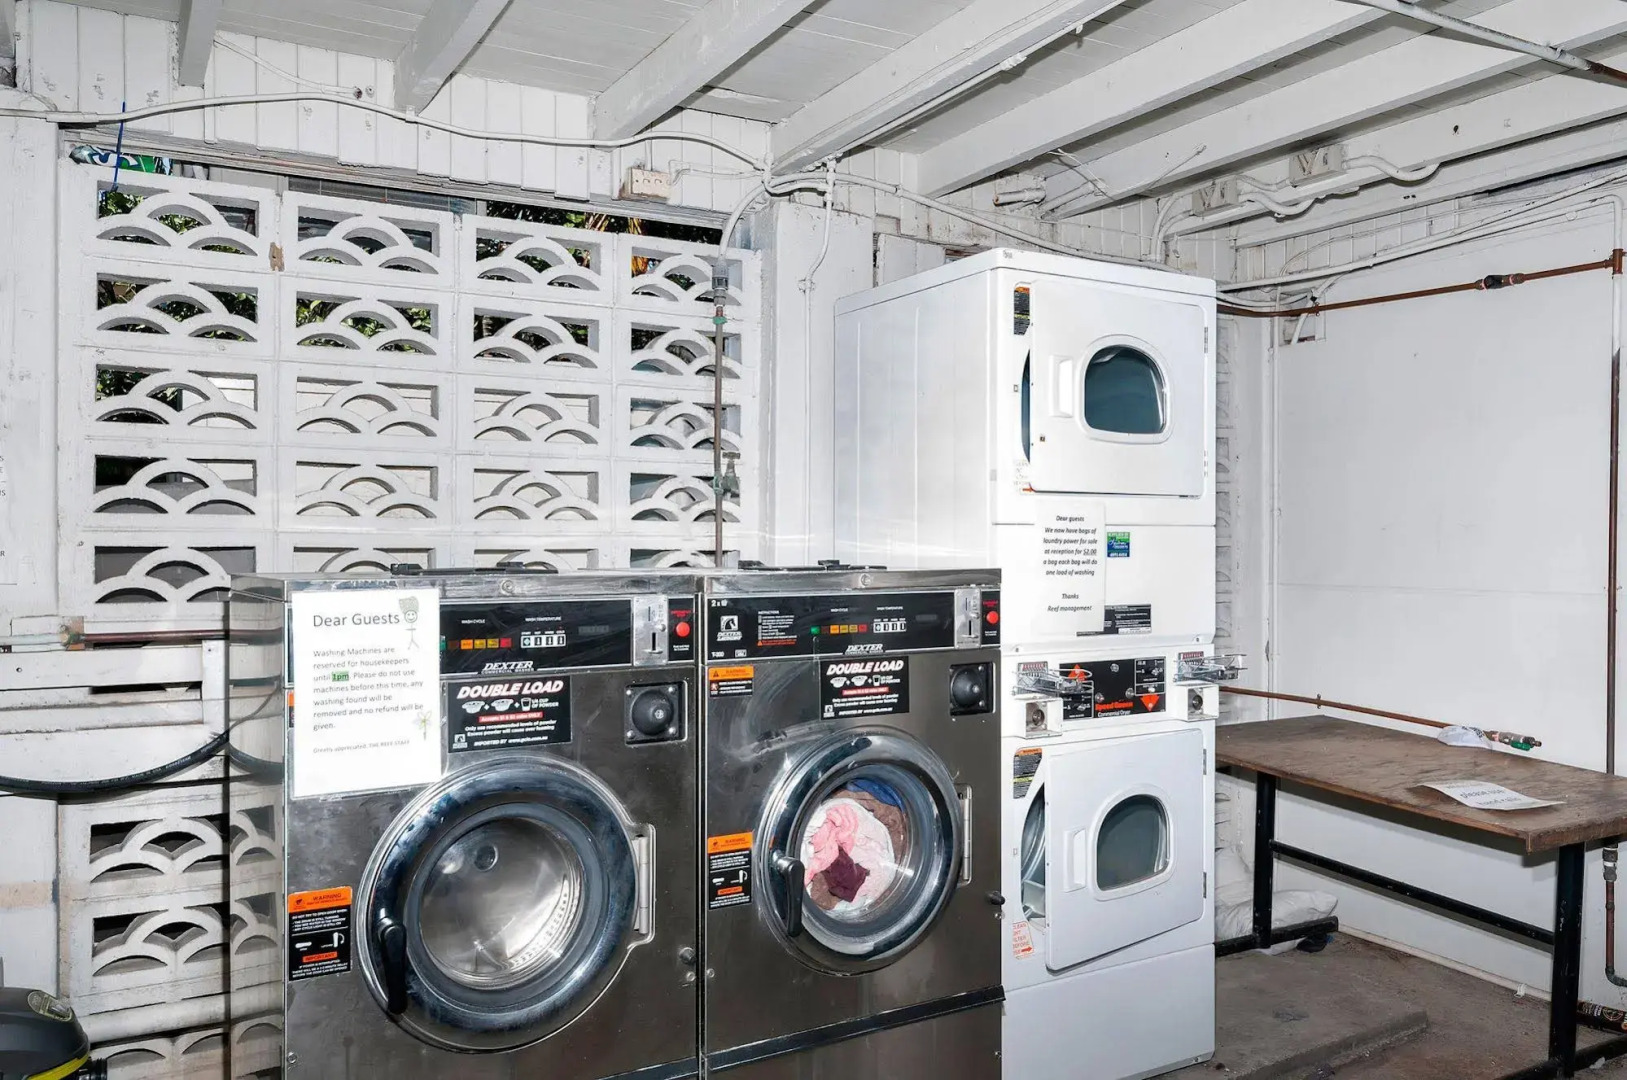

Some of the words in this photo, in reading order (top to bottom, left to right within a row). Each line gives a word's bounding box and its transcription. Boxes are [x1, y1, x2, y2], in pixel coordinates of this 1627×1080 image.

[313, 615, 347, 627] Dear
[351, 613, 400, 626] Guests
[313, 649, 346, 657] Washing
[313, 661, 345, 669] reserved
[360, 657, 409, 666] housekeepers
[483, 661, 533, 670] DEXTER
[826, 662, 874, 675] DOUBLE
[873, 660, 904, 672] LOAD
[353, 671, 377, 679] Please
[313, 686, 348, 694] machines
[456, 683, 522, 699] DOUBLE
[522, 680, 564, 694] LOAD
[313, 698, 344, 706] washing
[313, 709, 346, 717] removed
[349, 707, 363, 715] and
[376, 705, 399, 713] refund
[313, 723, 335, 731] given.
